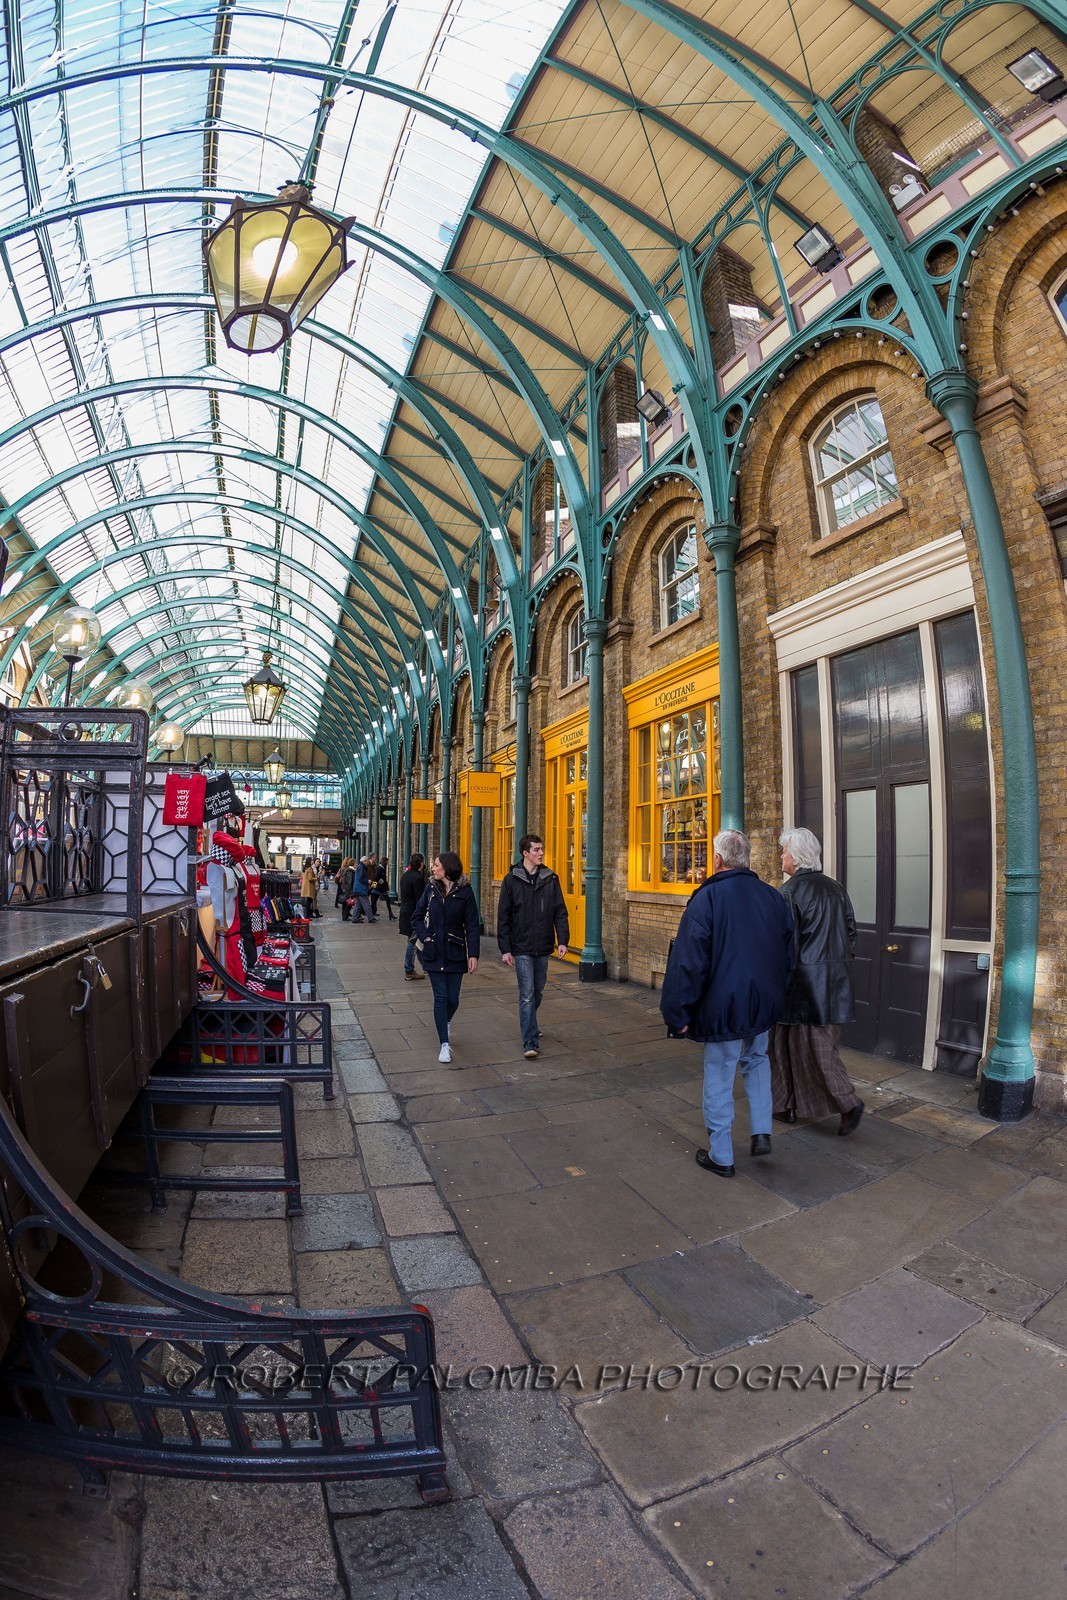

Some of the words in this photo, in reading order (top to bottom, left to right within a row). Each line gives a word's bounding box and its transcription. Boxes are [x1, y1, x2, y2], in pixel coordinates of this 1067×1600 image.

[654, 681, 696, 707] L'OCCITANE
[205, 792, 221, 804] orget
[217, 797, 232, 806] have
[175, 811, 188, 819] chef
[211, 805, 230, 815] dinner
